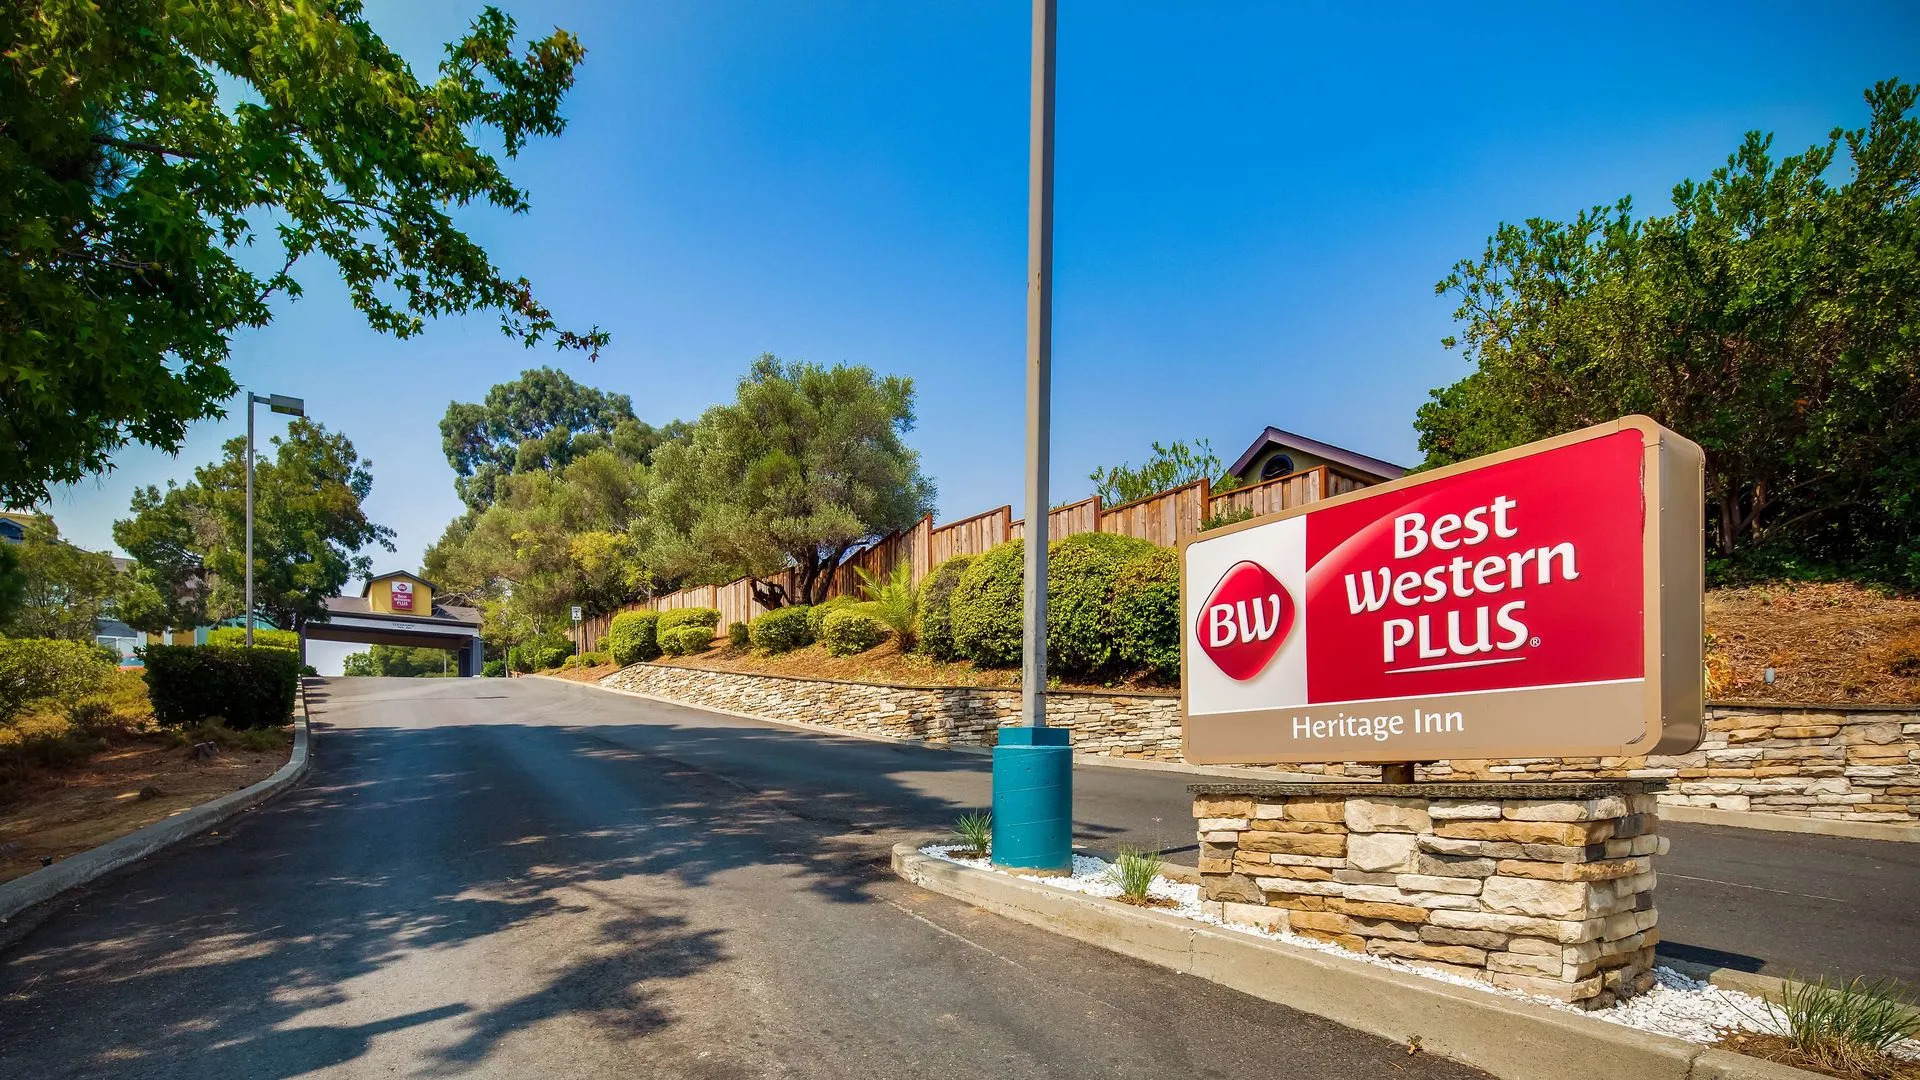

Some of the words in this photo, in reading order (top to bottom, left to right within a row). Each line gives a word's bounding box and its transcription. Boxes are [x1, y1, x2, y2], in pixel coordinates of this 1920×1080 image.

[1393, 496, 1518, 560] Best
[1344, 541, 1580, 615] Western
[1208, 594, 1281, 648] BW
[1292, 714, 1404, 741] Heritage
[1414, 708, 1465, 733] Inn
